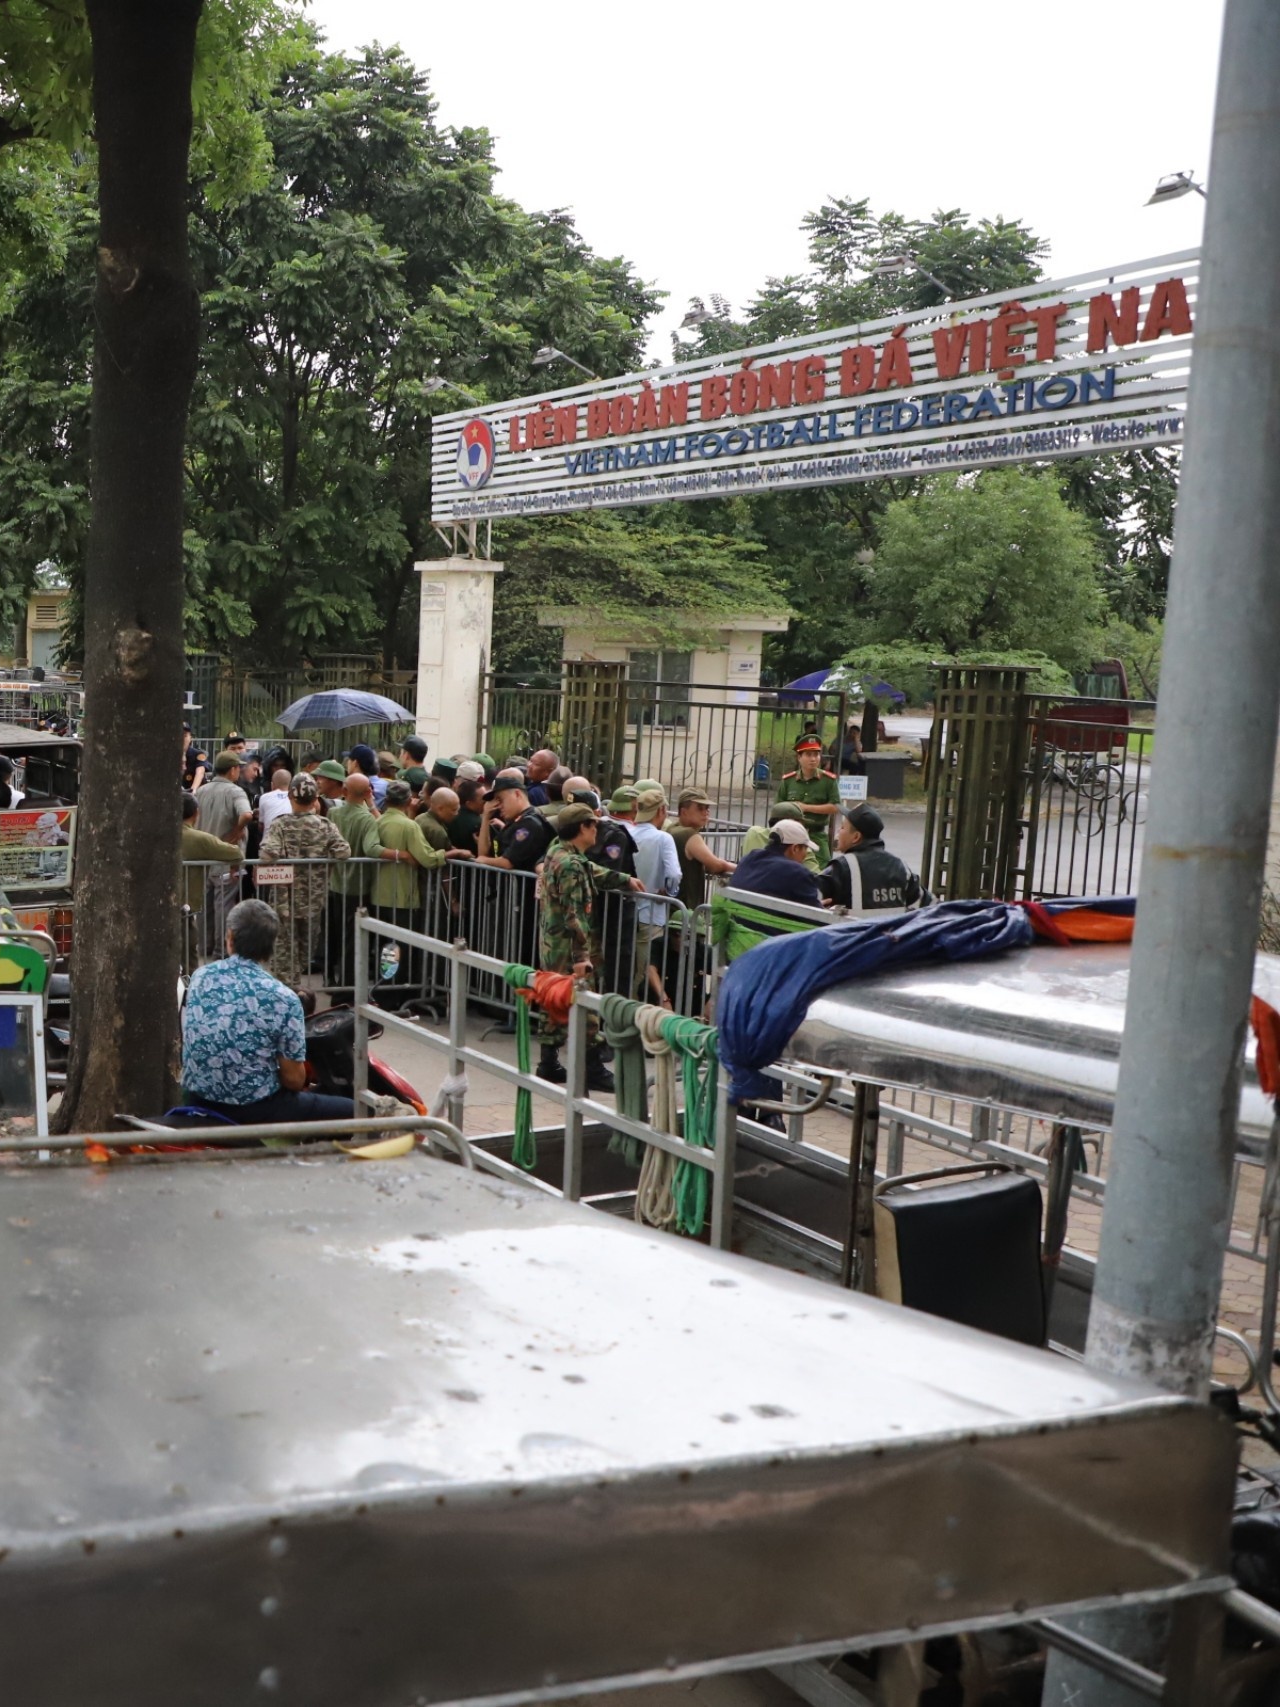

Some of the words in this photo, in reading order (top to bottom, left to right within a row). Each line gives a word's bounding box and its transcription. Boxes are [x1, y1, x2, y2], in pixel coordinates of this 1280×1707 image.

[509, 400, 578, 452] LIÊN
[587, 379, 689, 439] ĐOÀN
[701, 356, 826, 421] BÓNG
[840, 324, 913, 397] ĐÁ
[932, 301, 1068, 380] VIỆT
[1085, 277, 1194, 354] NA
[564, 438, 677, 476] VIETNAM
[685, 413, 844, 460] FOOTBALL
[854, 367, 1116, 438] FEDERATION
